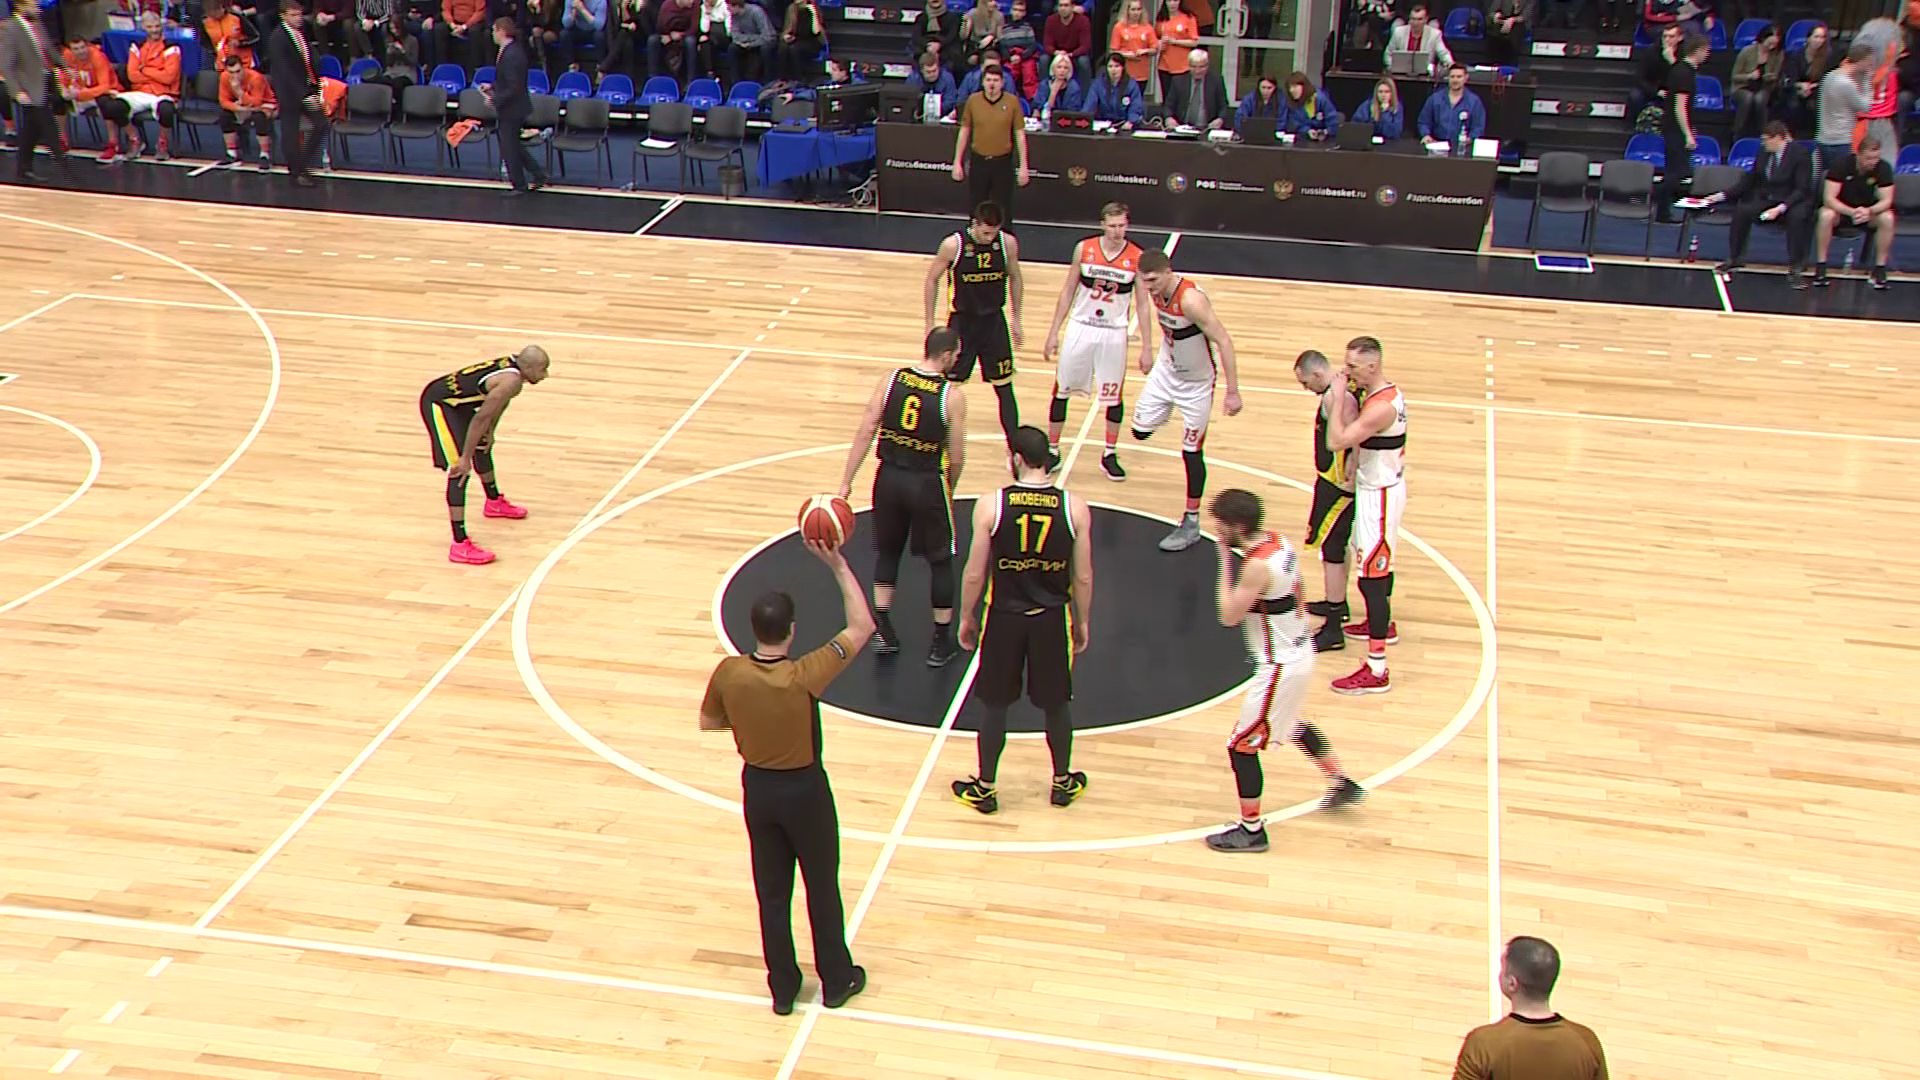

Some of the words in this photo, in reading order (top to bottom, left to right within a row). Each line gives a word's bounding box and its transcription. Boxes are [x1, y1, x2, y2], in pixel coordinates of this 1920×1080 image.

[885, 157, 954, 172] #здесьбаскетбо
[1094, 173, 1158, 186] russiabasket.ru
[1195, 179, 1216, 190] РФБ
[1300, 187, 1366, 199] russiabasket.ru
[1406, 193, 1483, 206] #здесьбаскетбол
[977, 252, 992, 269] 12
[962, 271, 1004, 283] VOSTOK
[1090, 278, 1119, 303] 52
[998, 359, 1012, 375] 12
[1102, 383, 1119, 397] 52
[900, 395, 921, 431] 6
[1184, 428, 1199, 443] 13
[1008, 491, 1059, 508] ЯКОВЕНКО
[1015, 512, 1053, 553] 17
